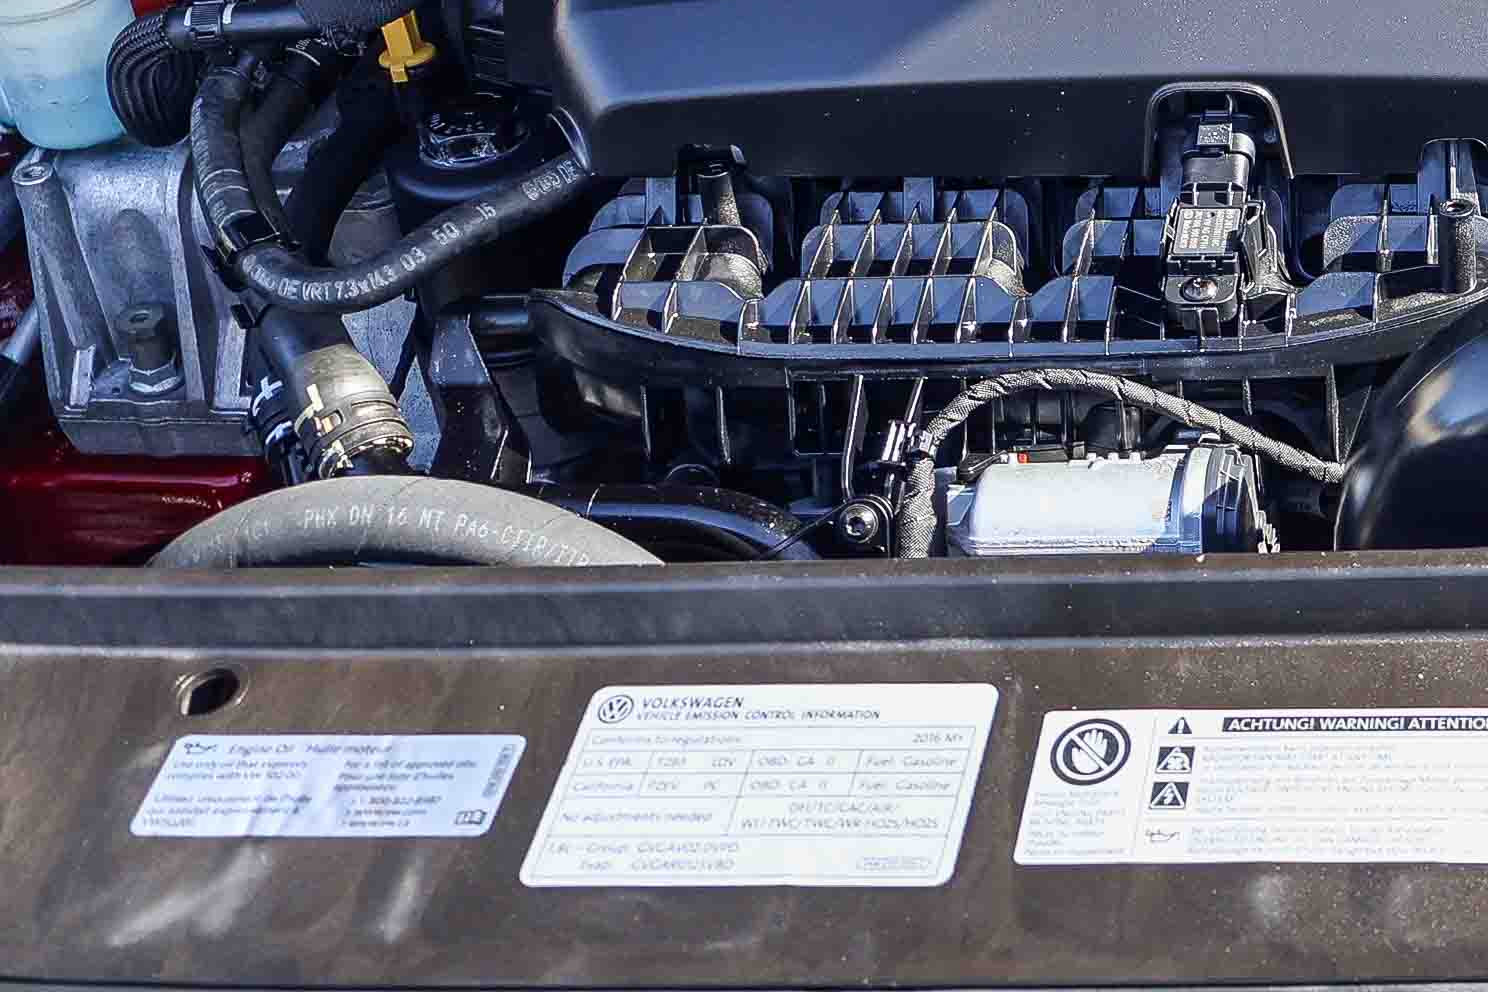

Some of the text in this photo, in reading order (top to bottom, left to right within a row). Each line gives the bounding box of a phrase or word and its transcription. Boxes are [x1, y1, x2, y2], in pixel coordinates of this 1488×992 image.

[643, 697, 745, 708] VOLKSWAGEN
[637, 710, 881, 720] VEHICLE EMISSION CONTROL INFORMATION
[1227, 718, 1315, 731] ACHTUNG!
[1319, 718, 1404, 731] WARNING!
[912, 734, 940, 744] 2016
